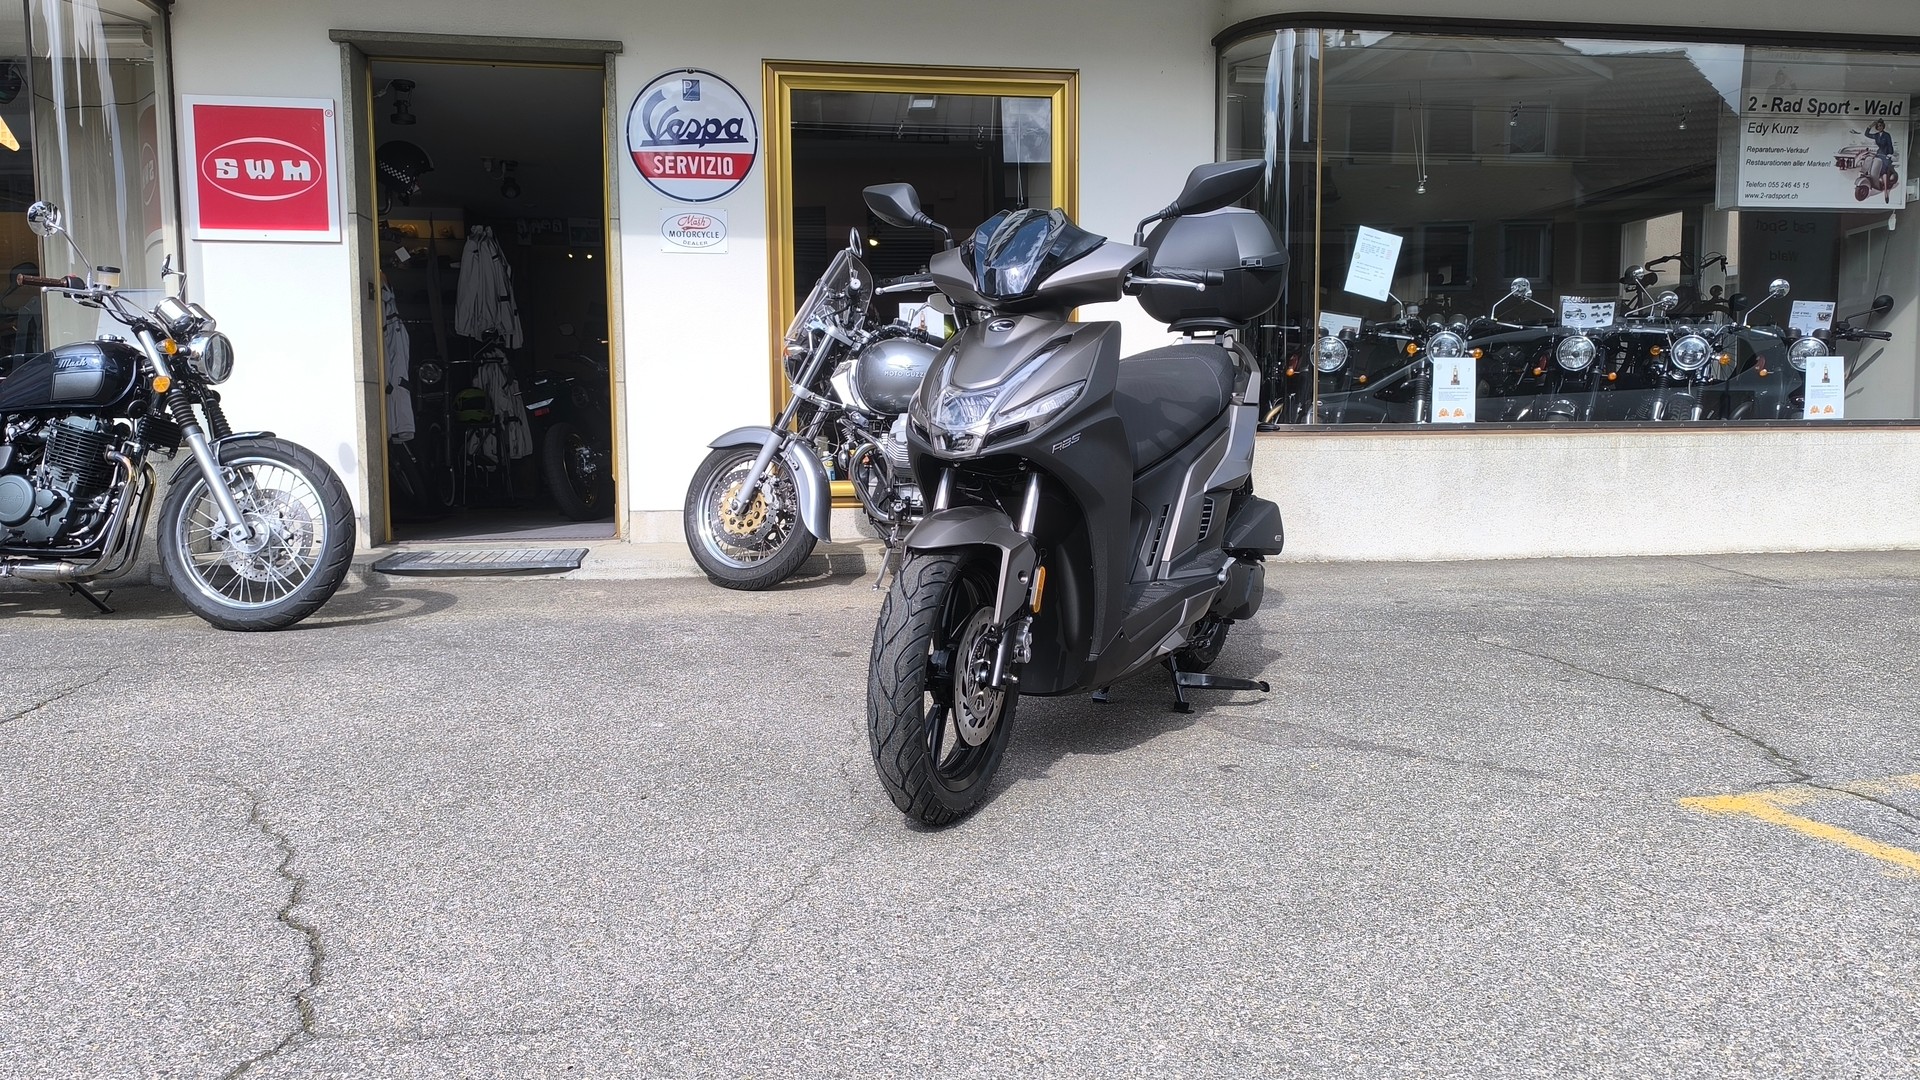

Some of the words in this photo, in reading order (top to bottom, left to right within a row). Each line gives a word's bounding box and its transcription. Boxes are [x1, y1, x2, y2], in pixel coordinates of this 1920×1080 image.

[1748, 96, 1758, 111] 2
[1771, 97, 1803, 112] Rad
[1807, 98, 1851, 117] Sport
[1864, 100, 1903, 116] Wald
[640, 89, 749, 149] Vespa
[1747, 122, 1769, 136] Edy
[1771, 122, 1799, 134] Kunz
[1746, 146, 1810, 154] Reparaturen-Verkauf
[653, 154, 734, 176] SERVIZIO
[1745, 158, 1791, 166] Restaurationen
[214, 158, 312, 182] SWM
[1745, 180, 1767, 188] Telefon
[1780, 181, 1792, 189] 246
[1744, 192, 1799, 200] www.2-radsport.ch
[680, 214, 709, 228] Mash
[668, 230, 720, 239] MOTORCYCLE
[58, 357, 88, 369] Mash
